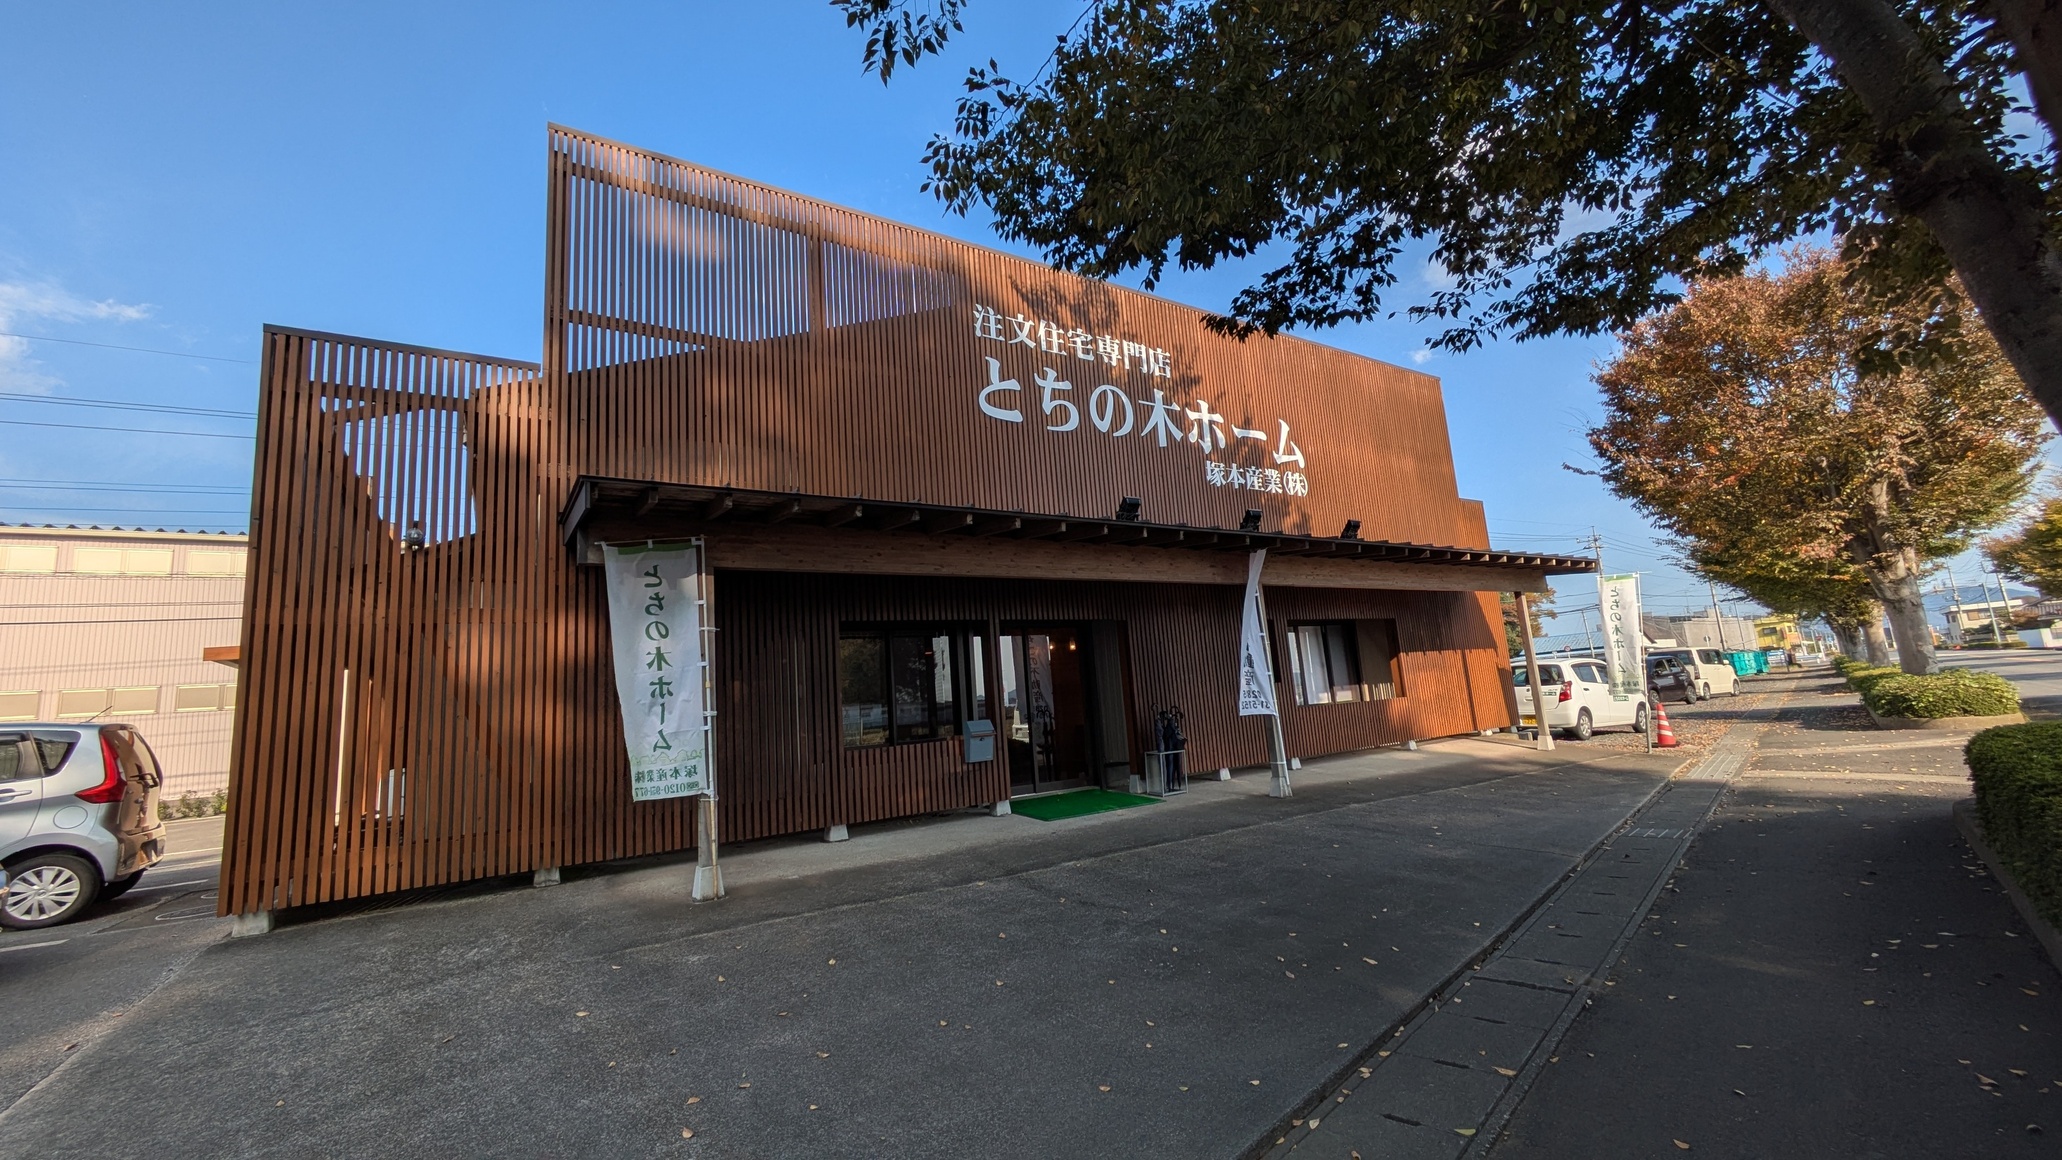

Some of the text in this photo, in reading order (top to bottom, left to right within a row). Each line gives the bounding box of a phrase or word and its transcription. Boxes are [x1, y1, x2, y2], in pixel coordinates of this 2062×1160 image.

[973, 303, 1172, 378] 注文住宅専門店
[978, 356, 1306, 468] とちの木ホーム
